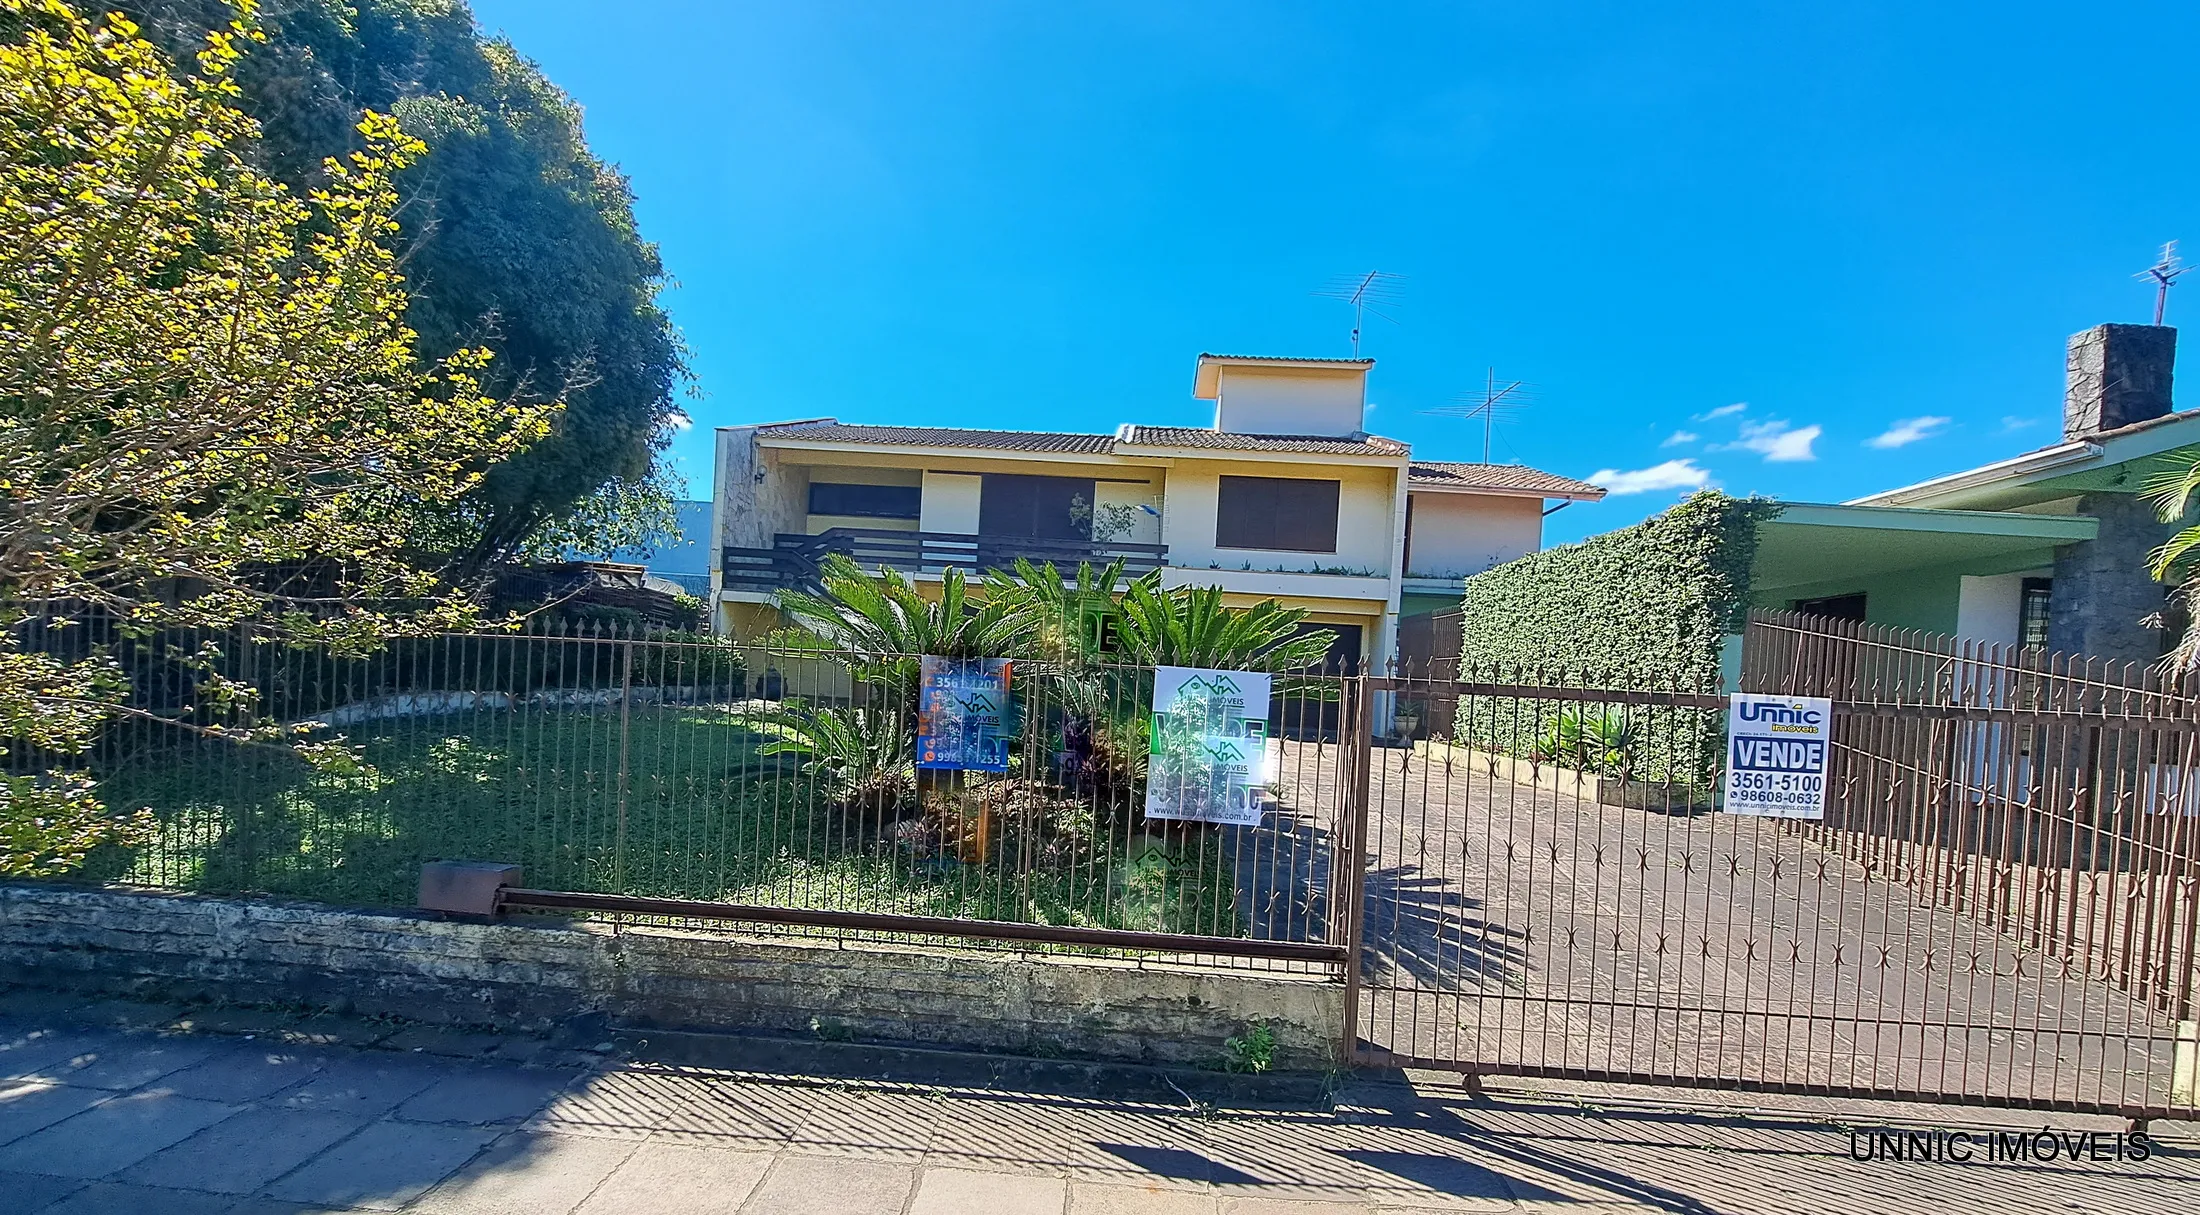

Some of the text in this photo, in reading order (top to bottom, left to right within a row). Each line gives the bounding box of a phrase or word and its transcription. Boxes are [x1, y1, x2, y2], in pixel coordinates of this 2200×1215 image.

[1740, 701, 1822, 725] Unnic
[1771, 723, 1819, 734] imóveis
[1737, 739, 1822, 770] VENDE
[1731, 772, 1821, 792] 3561-5100
[1740, 791, 1820, 805] 98608-0632
